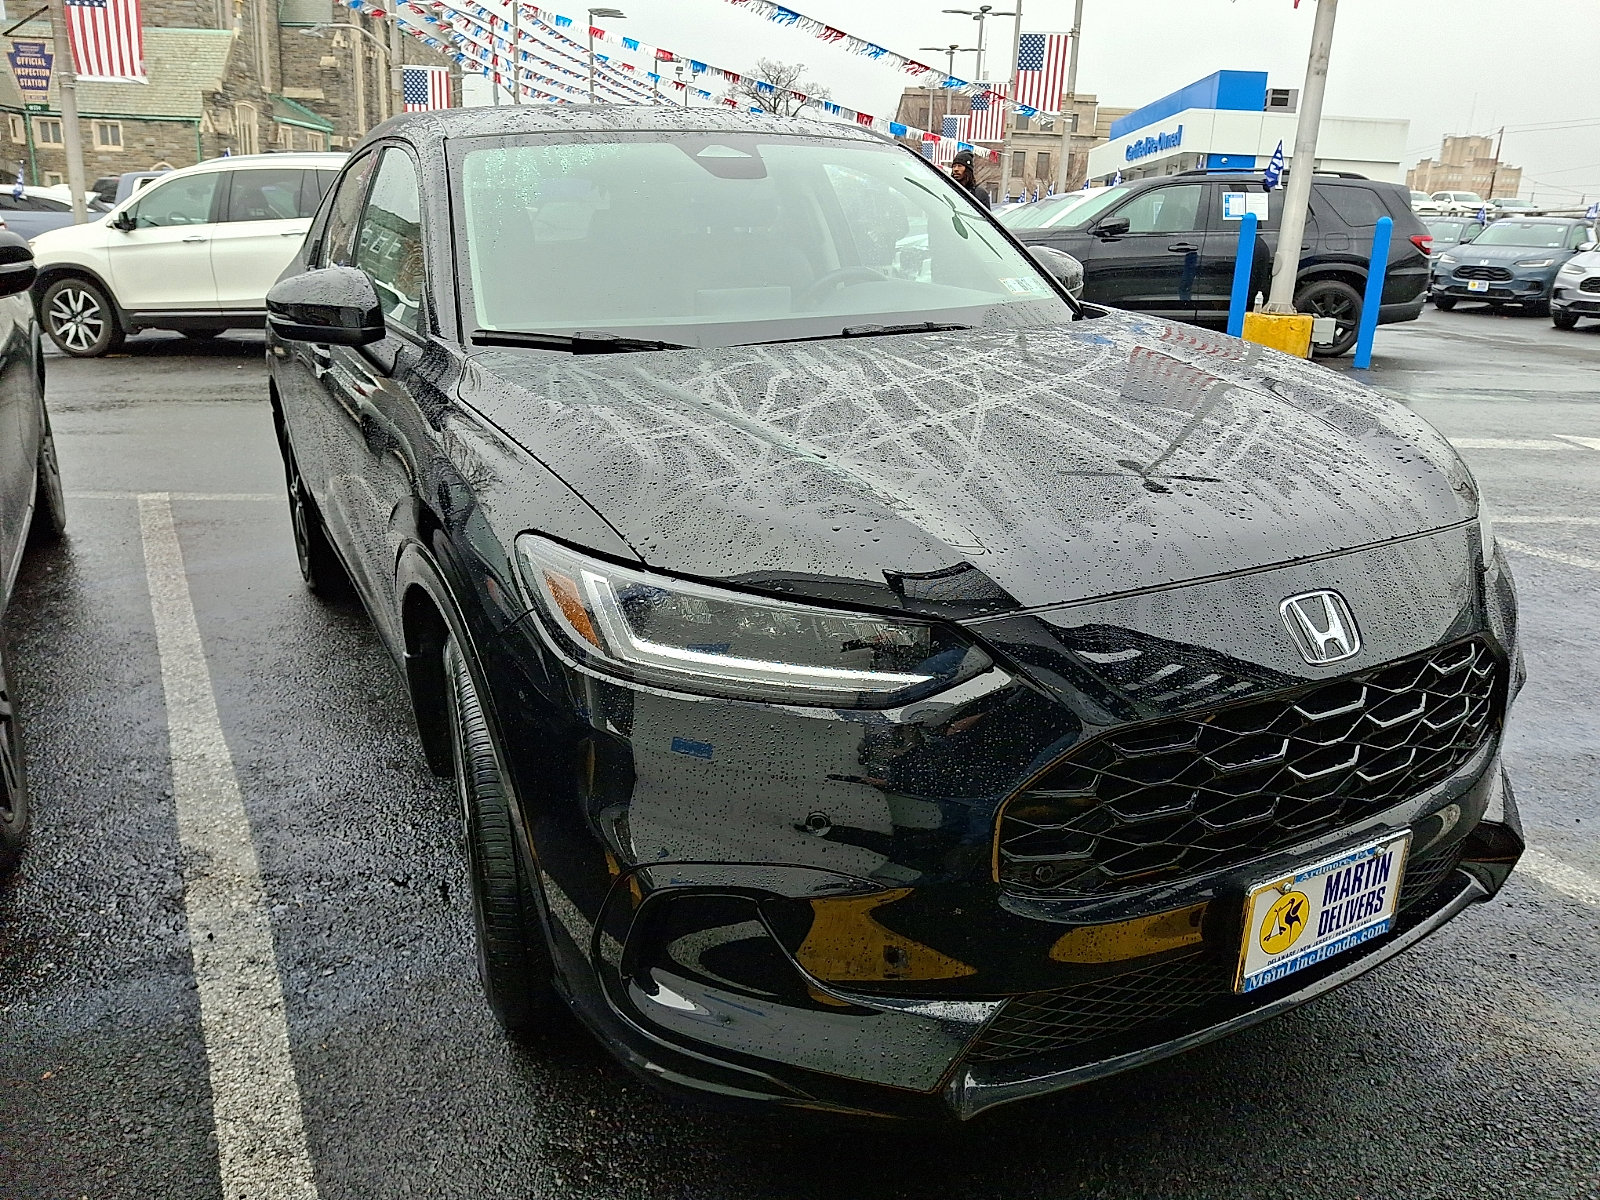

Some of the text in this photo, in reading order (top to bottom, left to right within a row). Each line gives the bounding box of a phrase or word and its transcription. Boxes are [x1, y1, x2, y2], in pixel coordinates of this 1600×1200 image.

[14, 68, 50, 77] INSPECTION
[16, 57, 46, 66] OFFICIAL
[19, 78, 47, 88] STATION
[1322, 851, 1393, 907] MARTIN
[1317, 886, 1386, 938] DELIVERS
[1248, 922, 1388, 988] MainLineHonda.com
